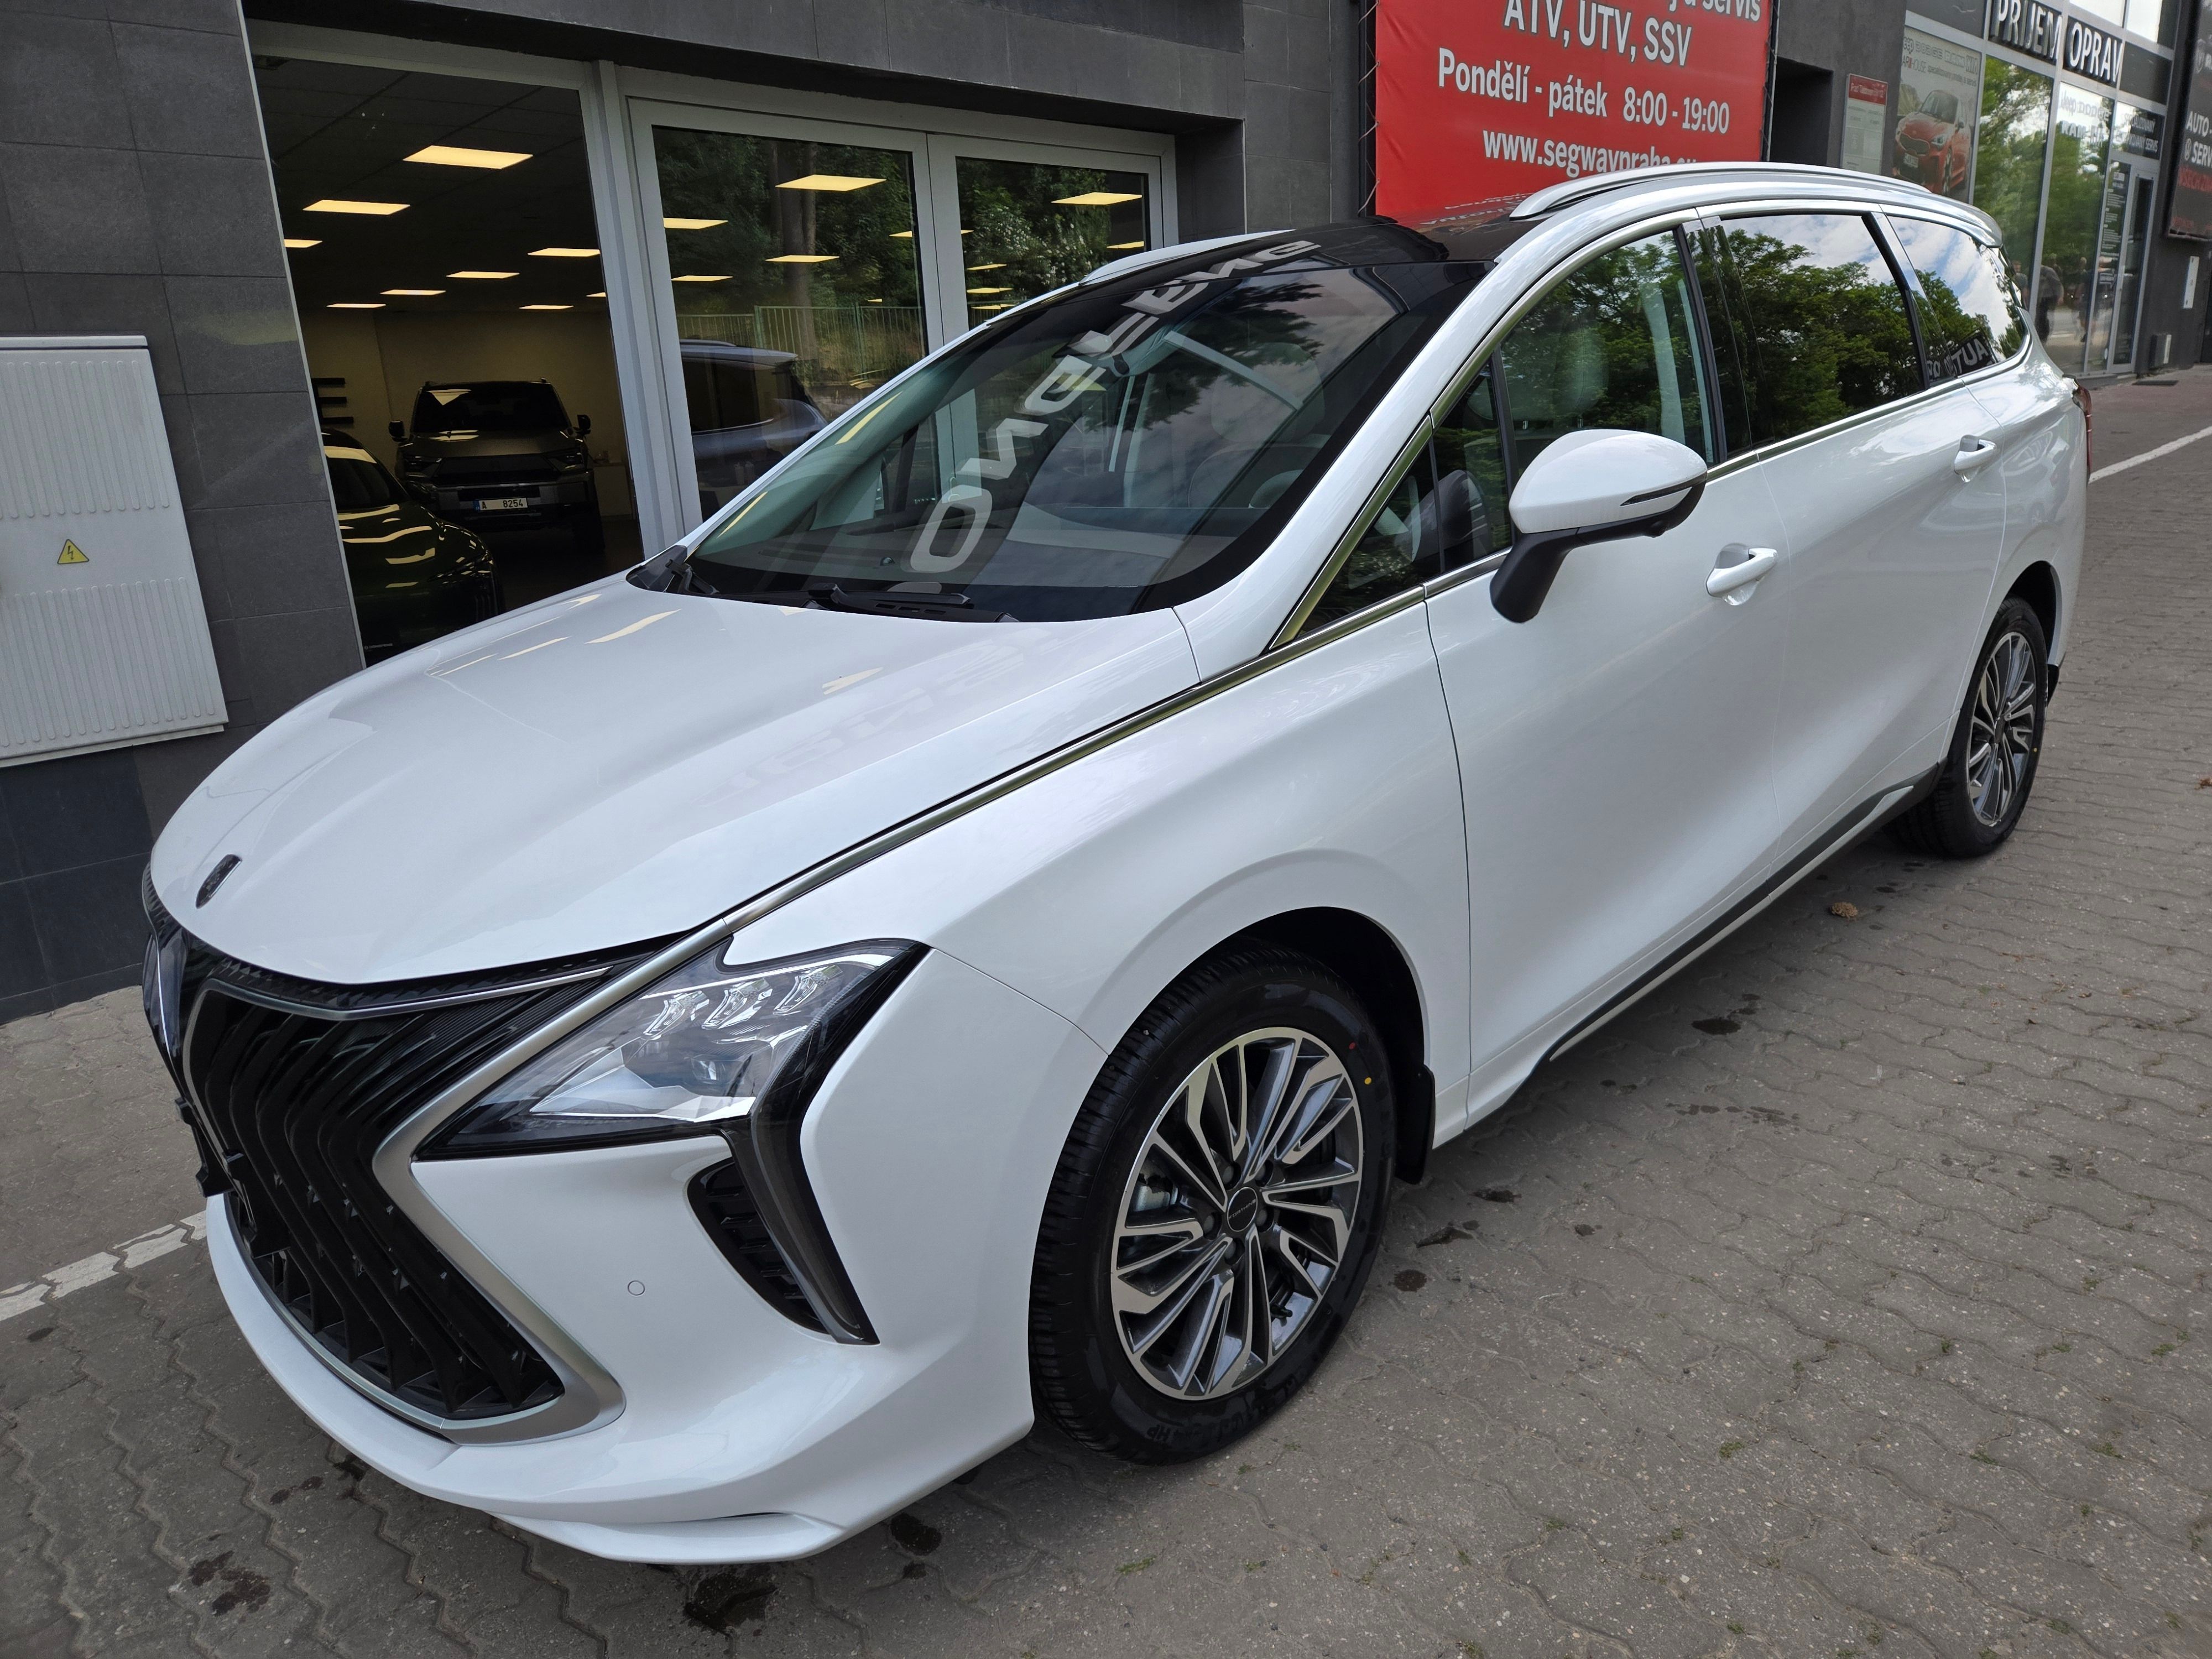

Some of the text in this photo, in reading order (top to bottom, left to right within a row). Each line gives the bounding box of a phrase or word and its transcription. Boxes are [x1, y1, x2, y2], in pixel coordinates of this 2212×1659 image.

[1504, 0, 1692, 66] ATV, UTV, SSV
[2069, 22, 2123, 82] OPRAV
[1439, 48, 1530, 103] Pondělí
[1548, 75, 1608, 117] pátek
[1623, 87, 1667, 126] 8:00
[1682, 97, 1729, 134] 19:00
[1483, 130, 1696, 178] www.segwayprah
[503, 499, 523, 508] 8254
